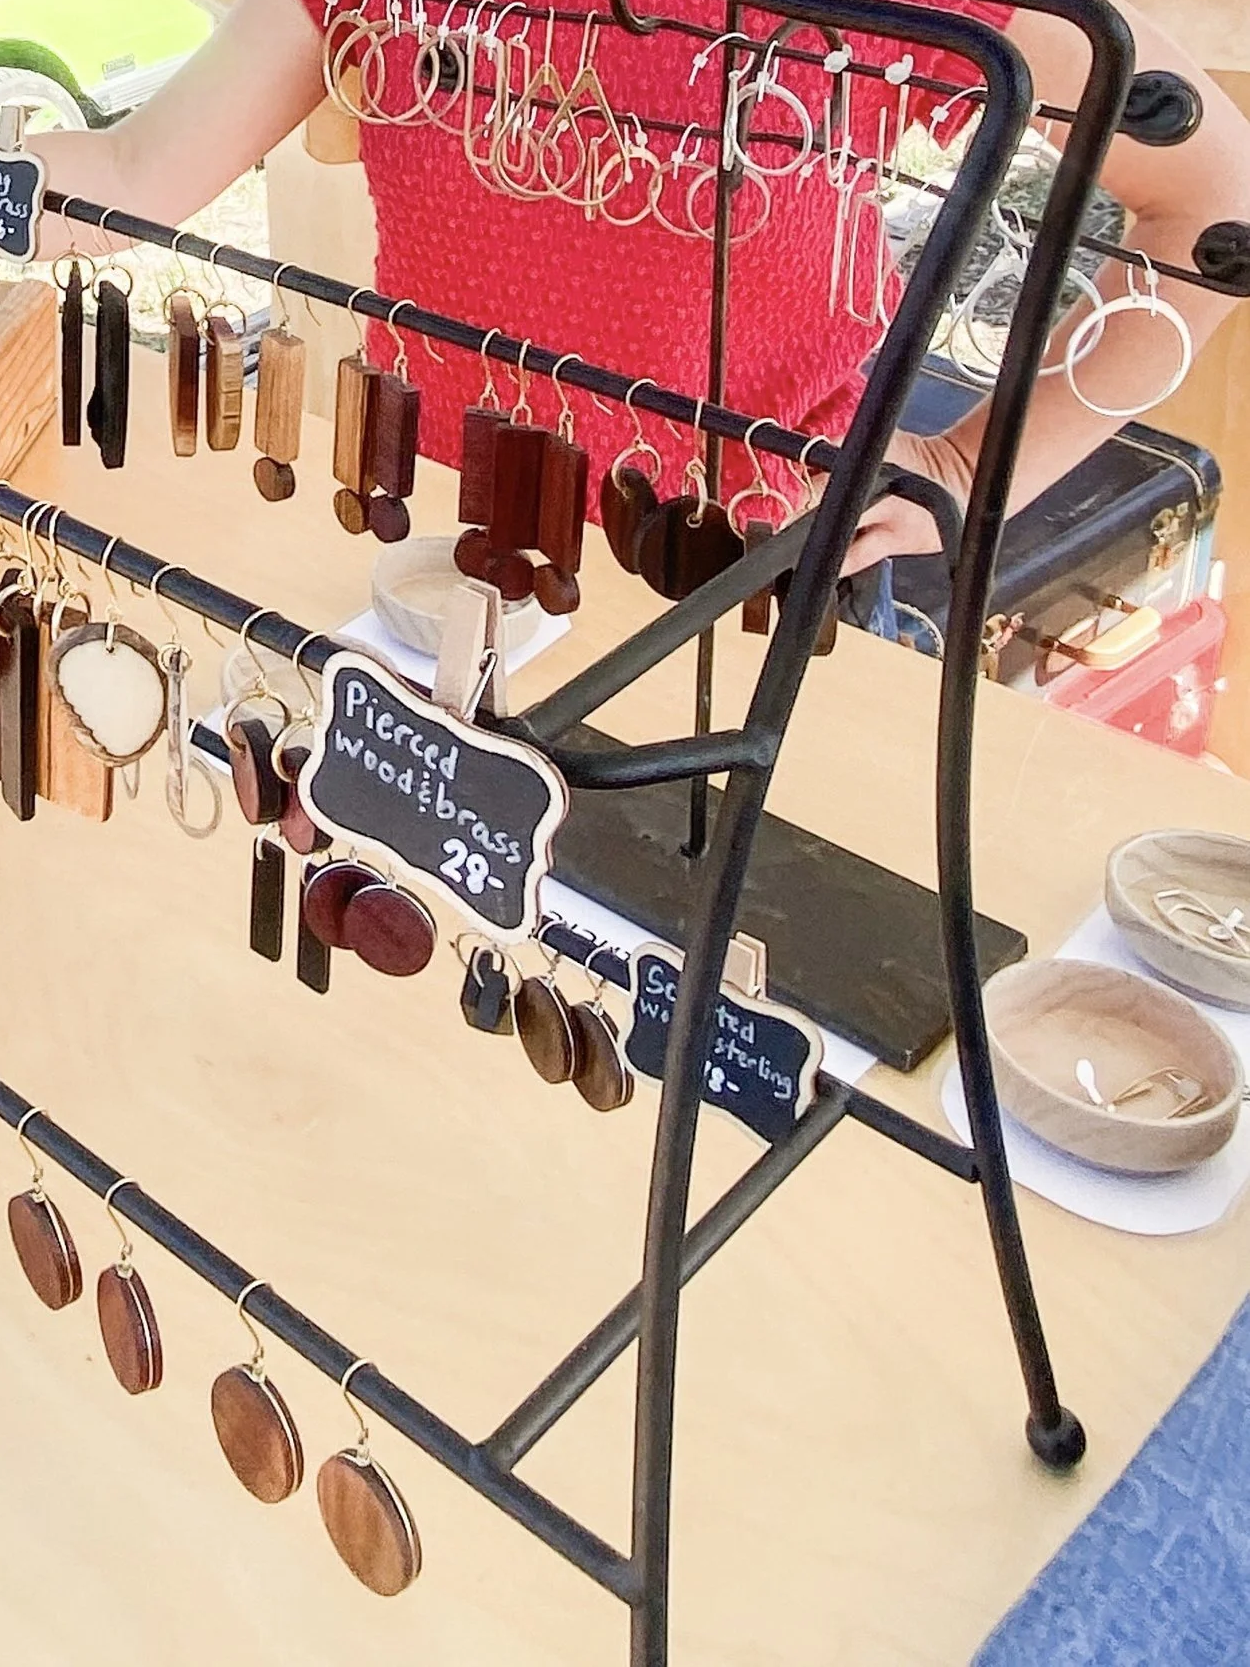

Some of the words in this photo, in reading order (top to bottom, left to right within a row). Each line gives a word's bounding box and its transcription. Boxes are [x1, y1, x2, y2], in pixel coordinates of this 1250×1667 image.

[345, 680, 459, 781] Pierced
[435, 780, 522, 864] brass
[714, 1036, 792, 1100] sterling
